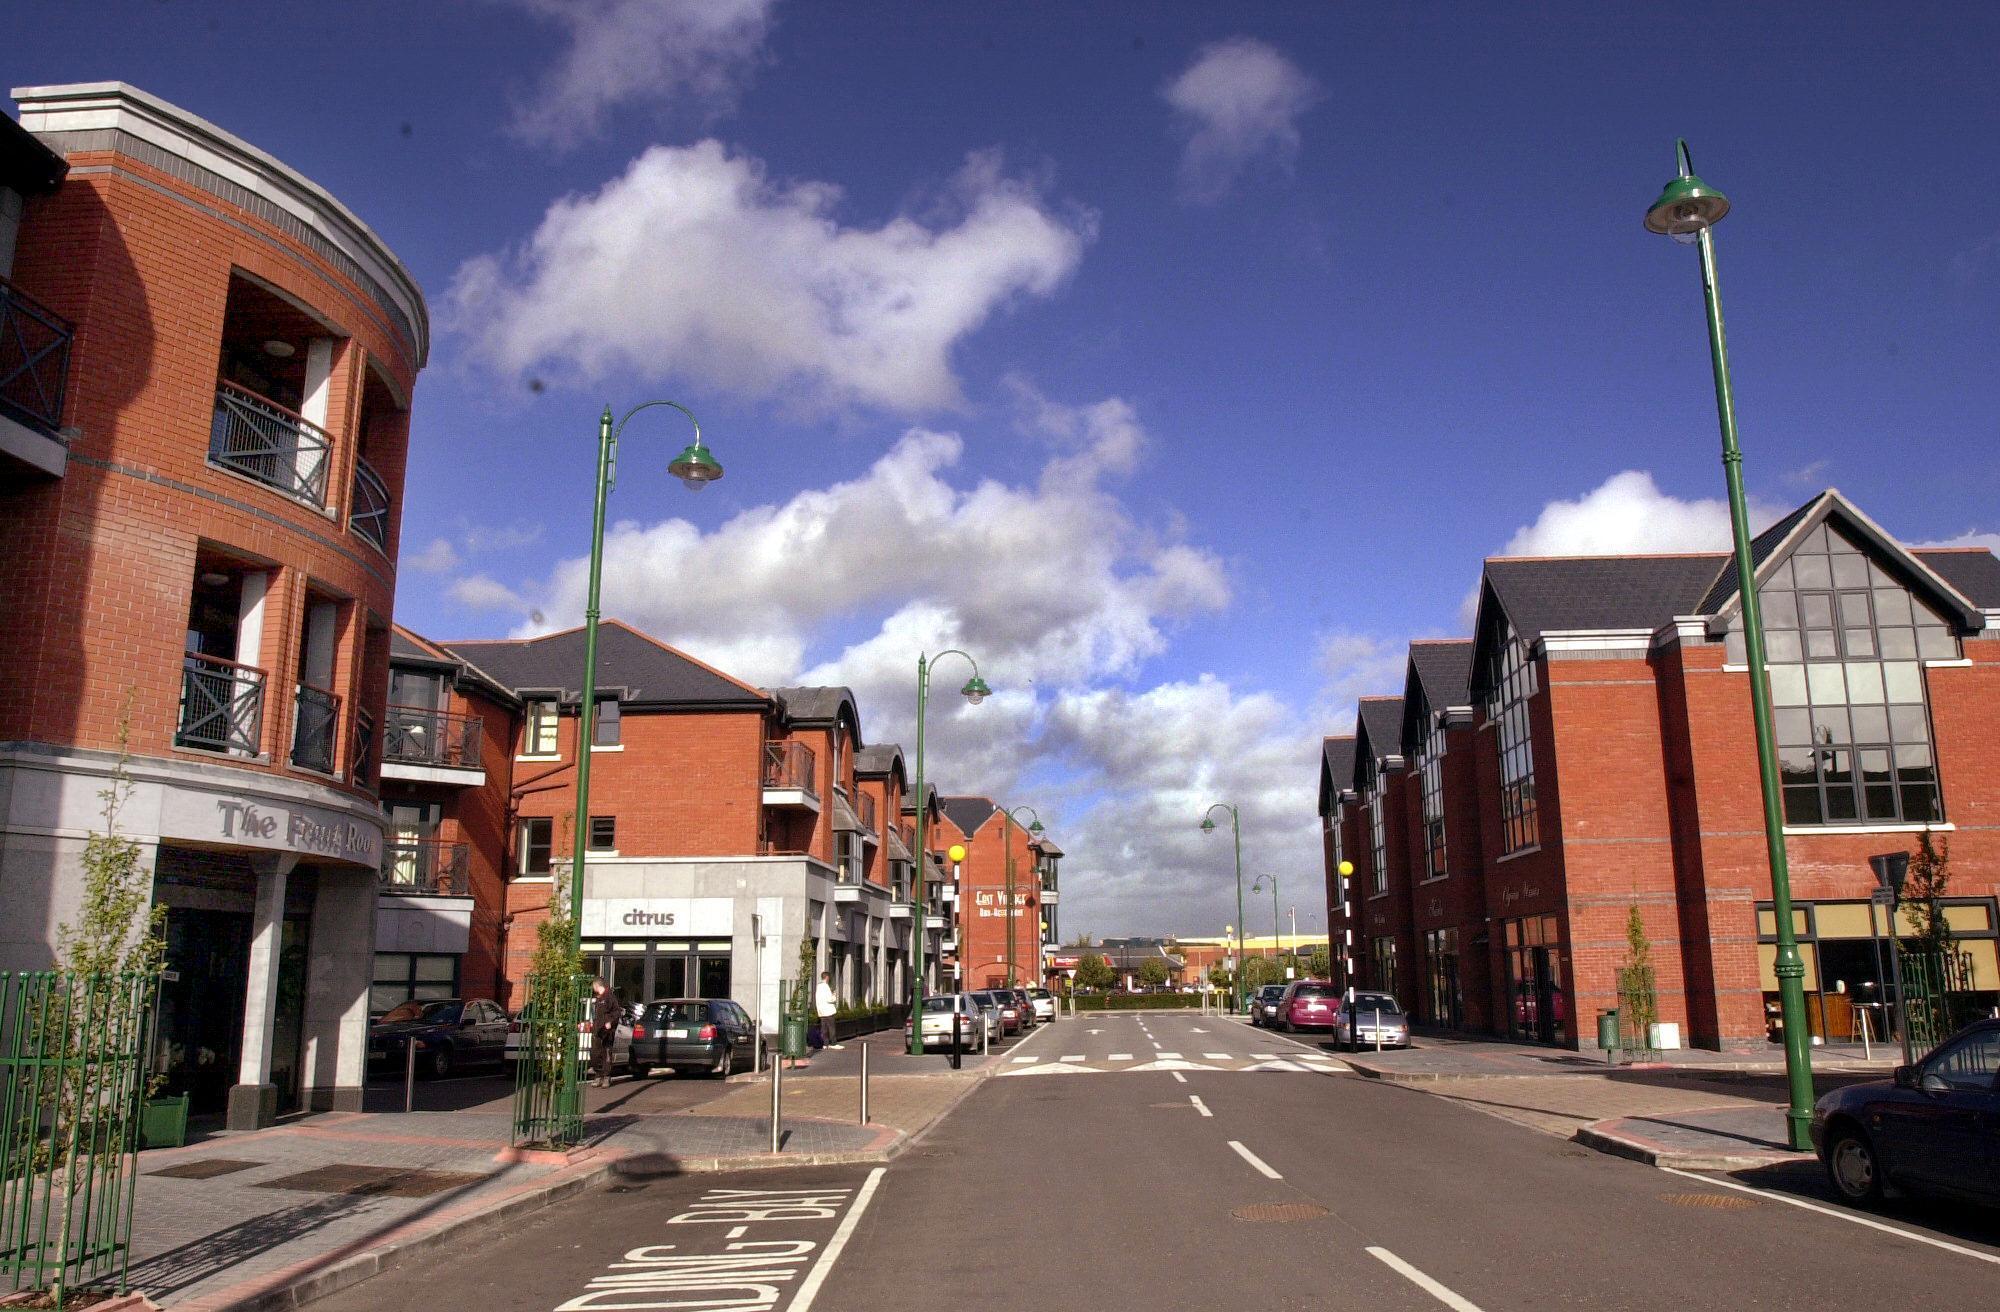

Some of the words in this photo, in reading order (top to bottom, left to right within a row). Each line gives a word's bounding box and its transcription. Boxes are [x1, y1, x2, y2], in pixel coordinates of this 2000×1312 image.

[217, 800, 277, 839] The
[286, 811, 342, 852] Front
[346, 823, 376, 854] Roo
[623, 908, 675, 925] citrus
